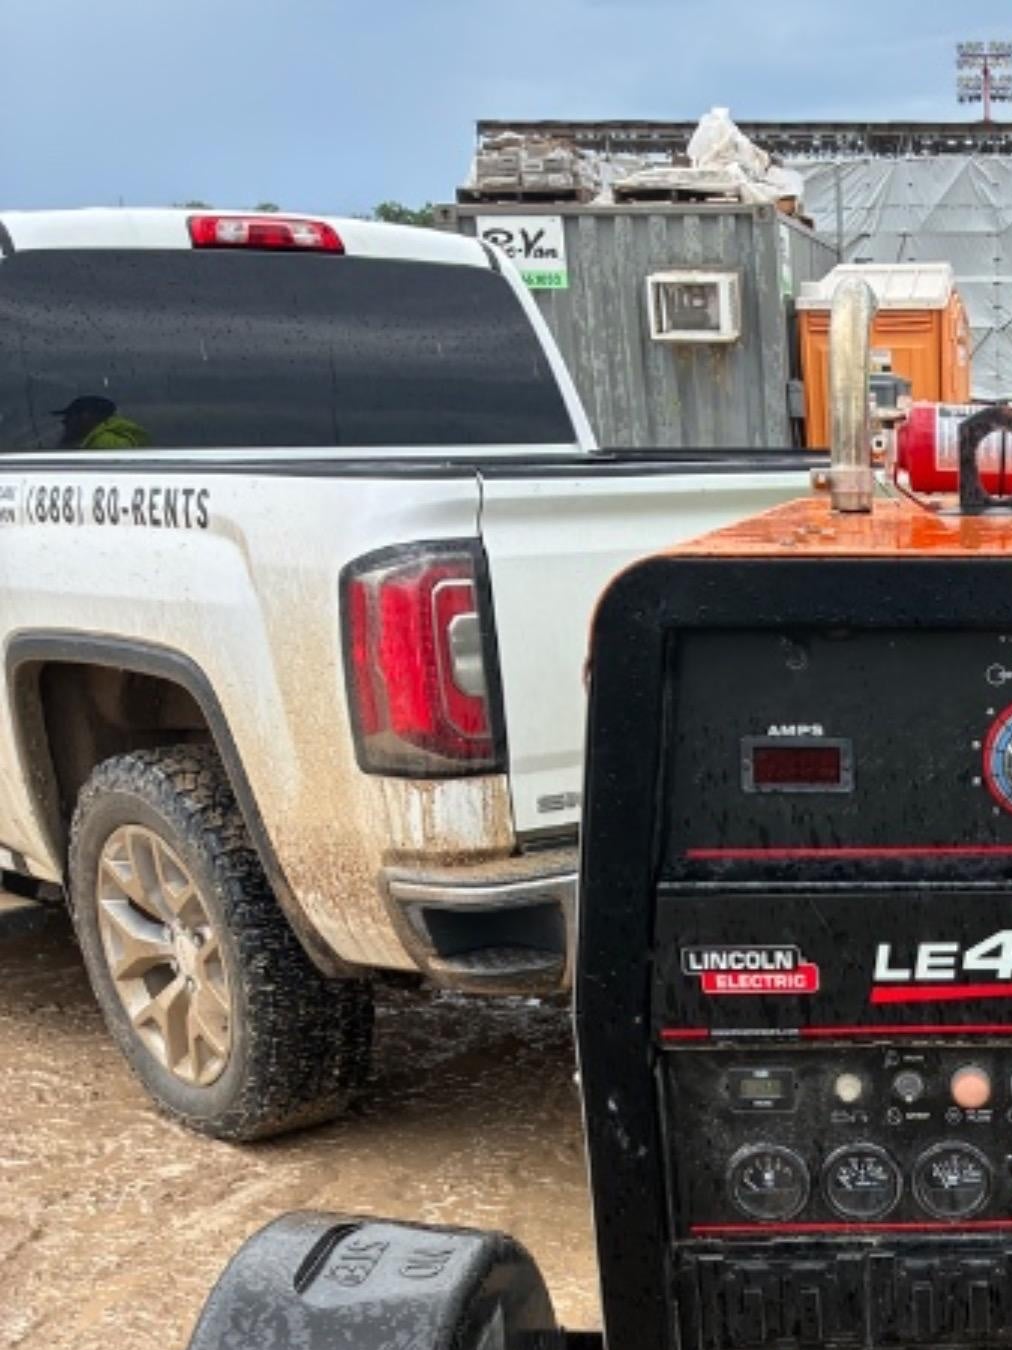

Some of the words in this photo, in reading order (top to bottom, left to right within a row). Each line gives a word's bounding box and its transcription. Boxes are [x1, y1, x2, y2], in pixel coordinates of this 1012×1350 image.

[26, 485, 85, 527] (888)
[92, 486, 211, 529] 80-RENTS
[767, 723, 824, 737] AMPS
[688, 950, 794, 971] LINCOLN
[715, 973, 808, 989] ELECTRIC
